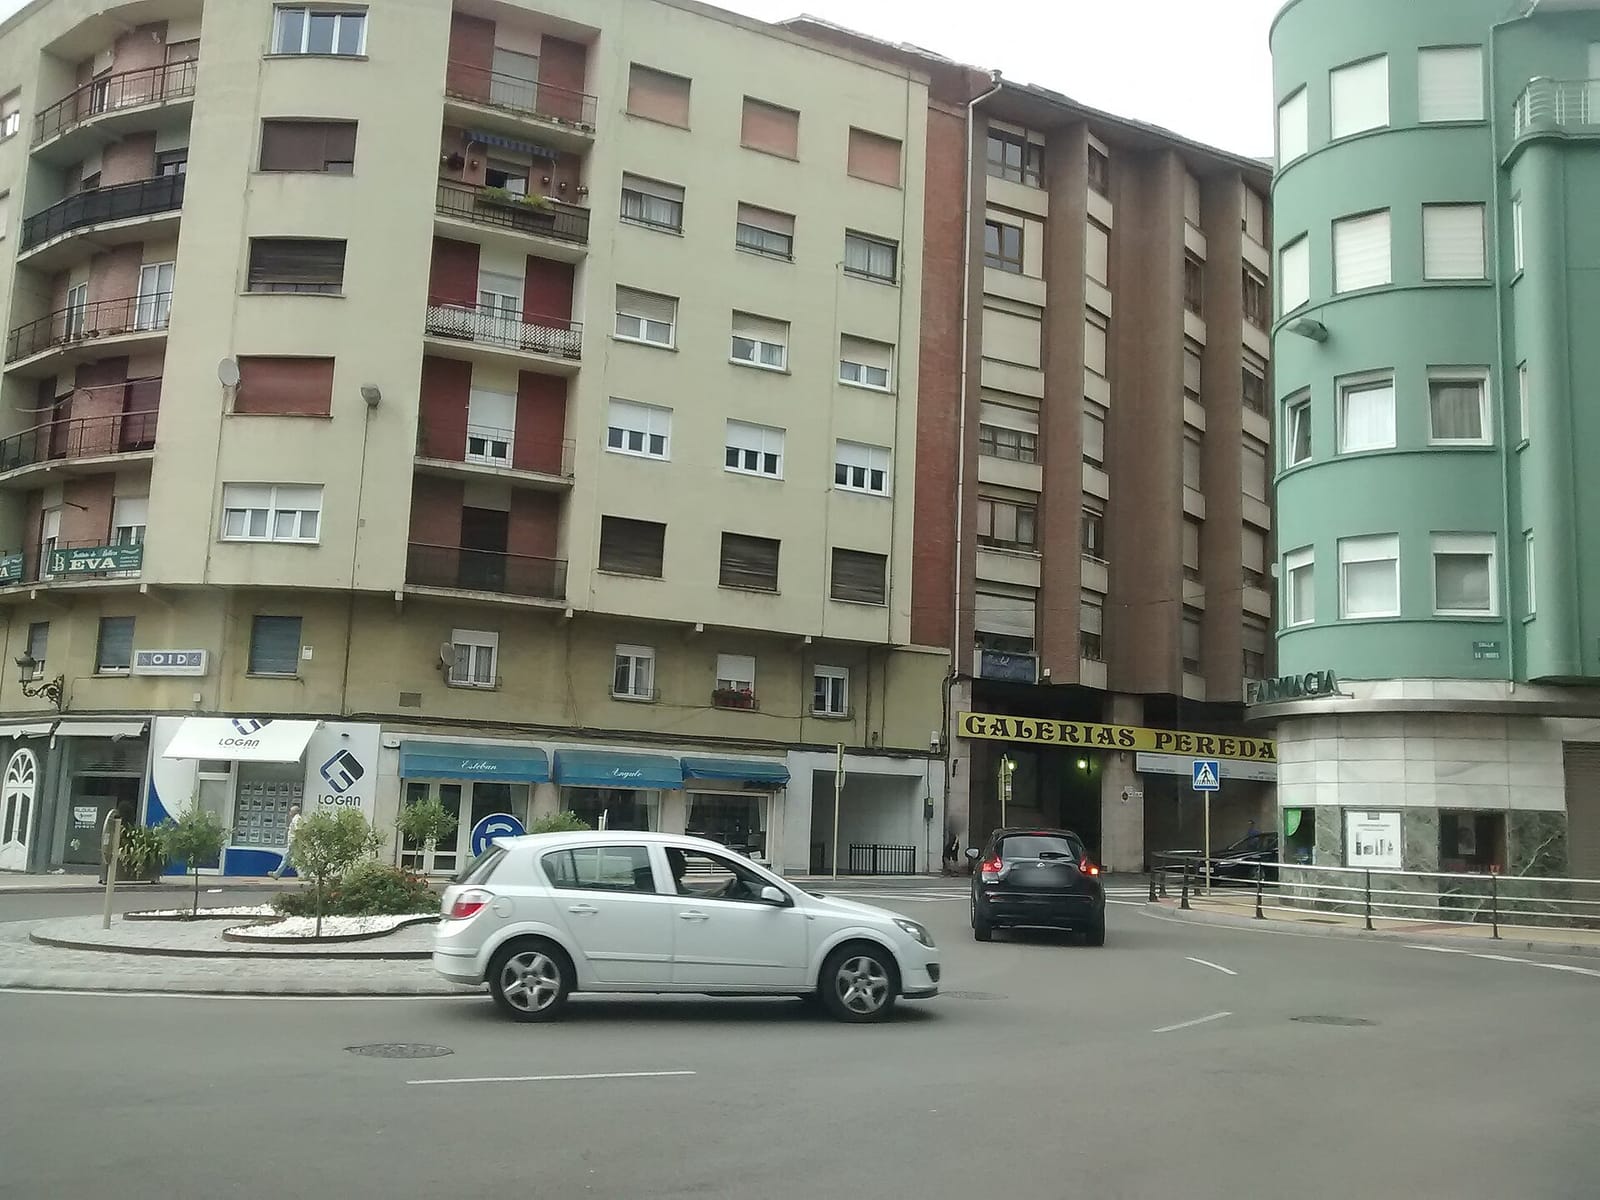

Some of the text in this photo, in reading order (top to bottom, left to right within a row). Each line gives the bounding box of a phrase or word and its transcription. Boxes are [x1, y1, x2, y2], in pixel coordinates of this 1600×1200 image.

[69, 557, 116, 571] EVA
[152, 654, 187, 664] OID
[1243, 669, 1341, 705] FARMACIA
[218, 738, 260, 747] LOGAN
[965, 715, 1277, 759] GALERIAS PEREDA
[318, 794, 361, 806] LOGAN
